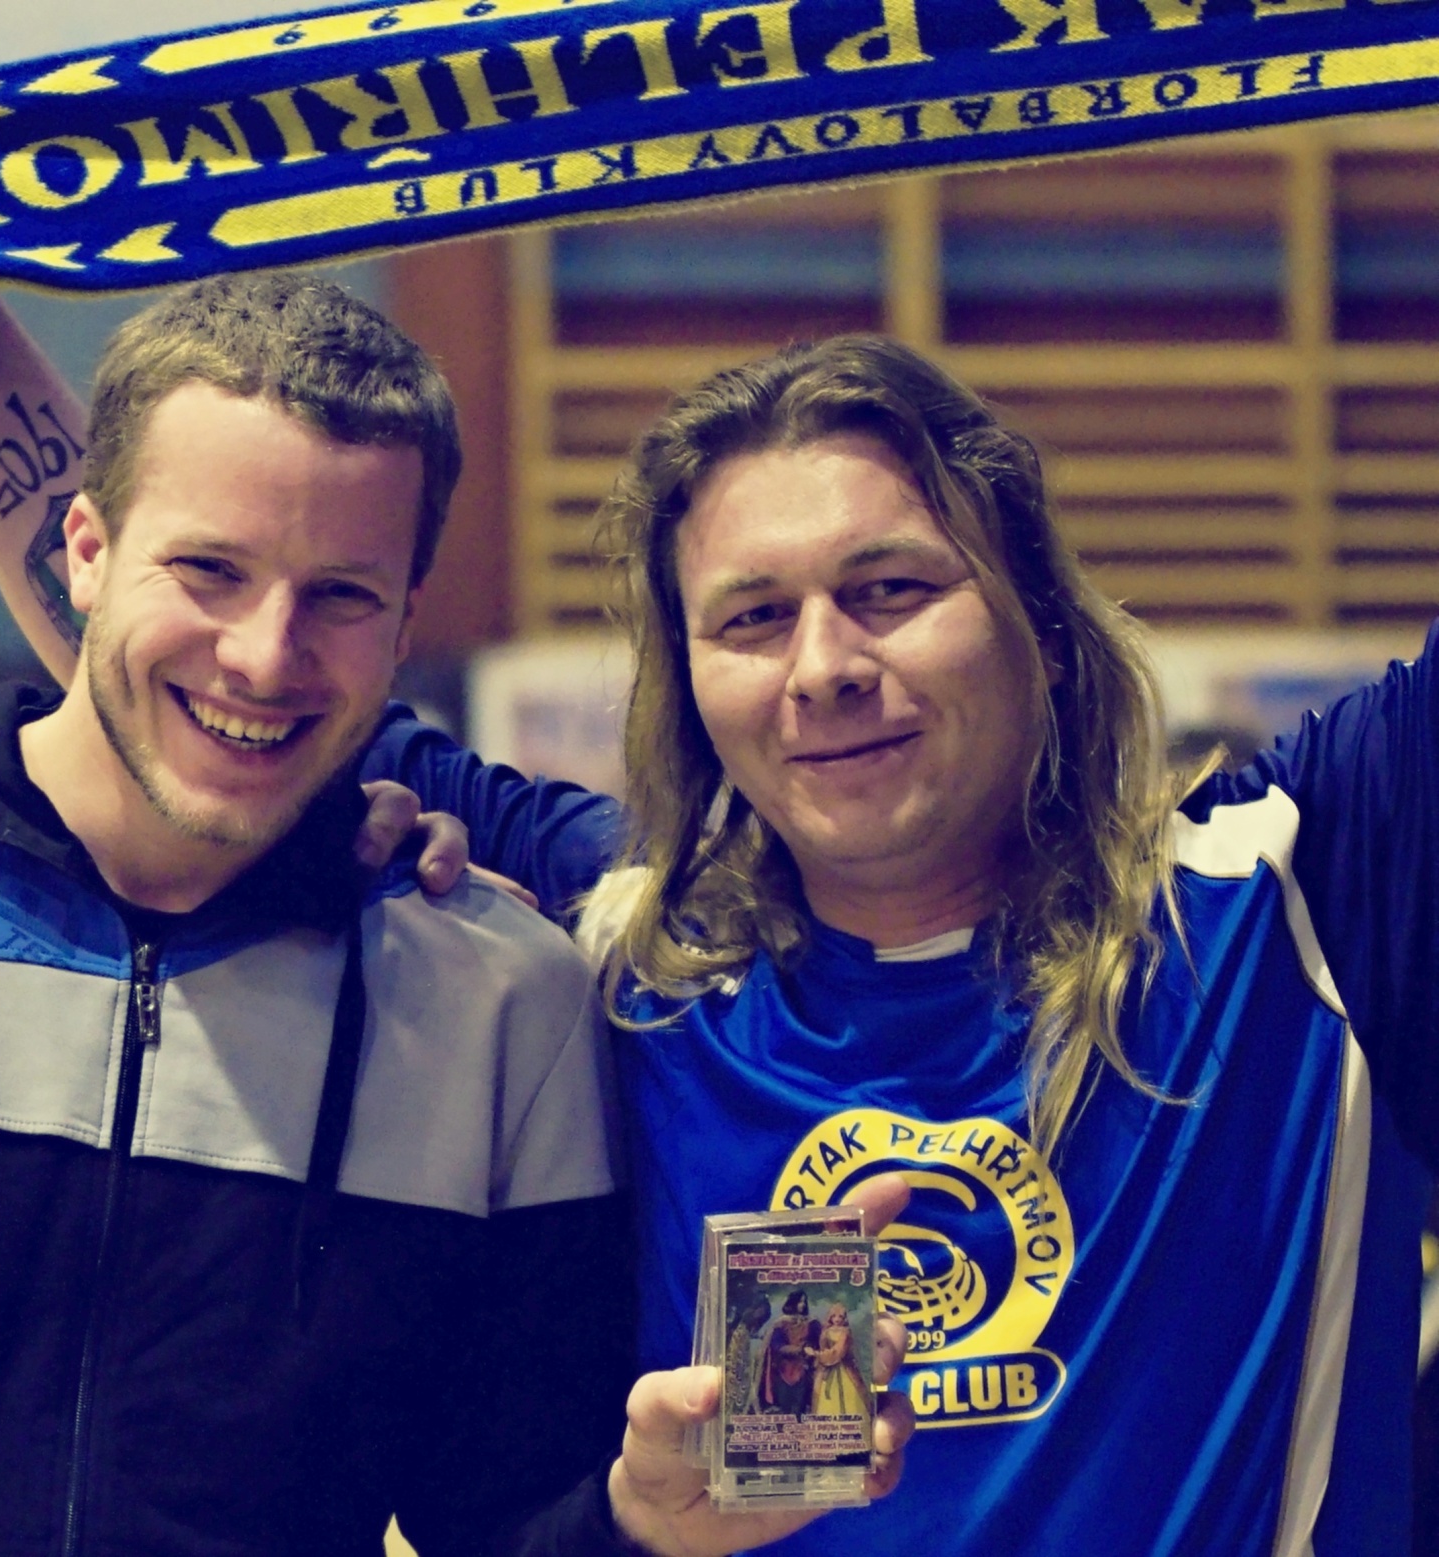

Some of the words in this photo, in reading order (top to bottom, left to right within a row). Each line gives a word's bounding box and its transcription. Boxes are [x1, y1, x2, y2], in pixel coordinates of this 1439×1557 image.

[273, 0, 571, 48] 999
[393, 145, 641, 215] KLUB
[783, 1121, 868, 1212] RTAK
[889, 1122, 1062, 1298] PELHŘIMOV
[907, 1331, 946, 1351] 999
[910, 1362, 1039, 1415] CLUB
